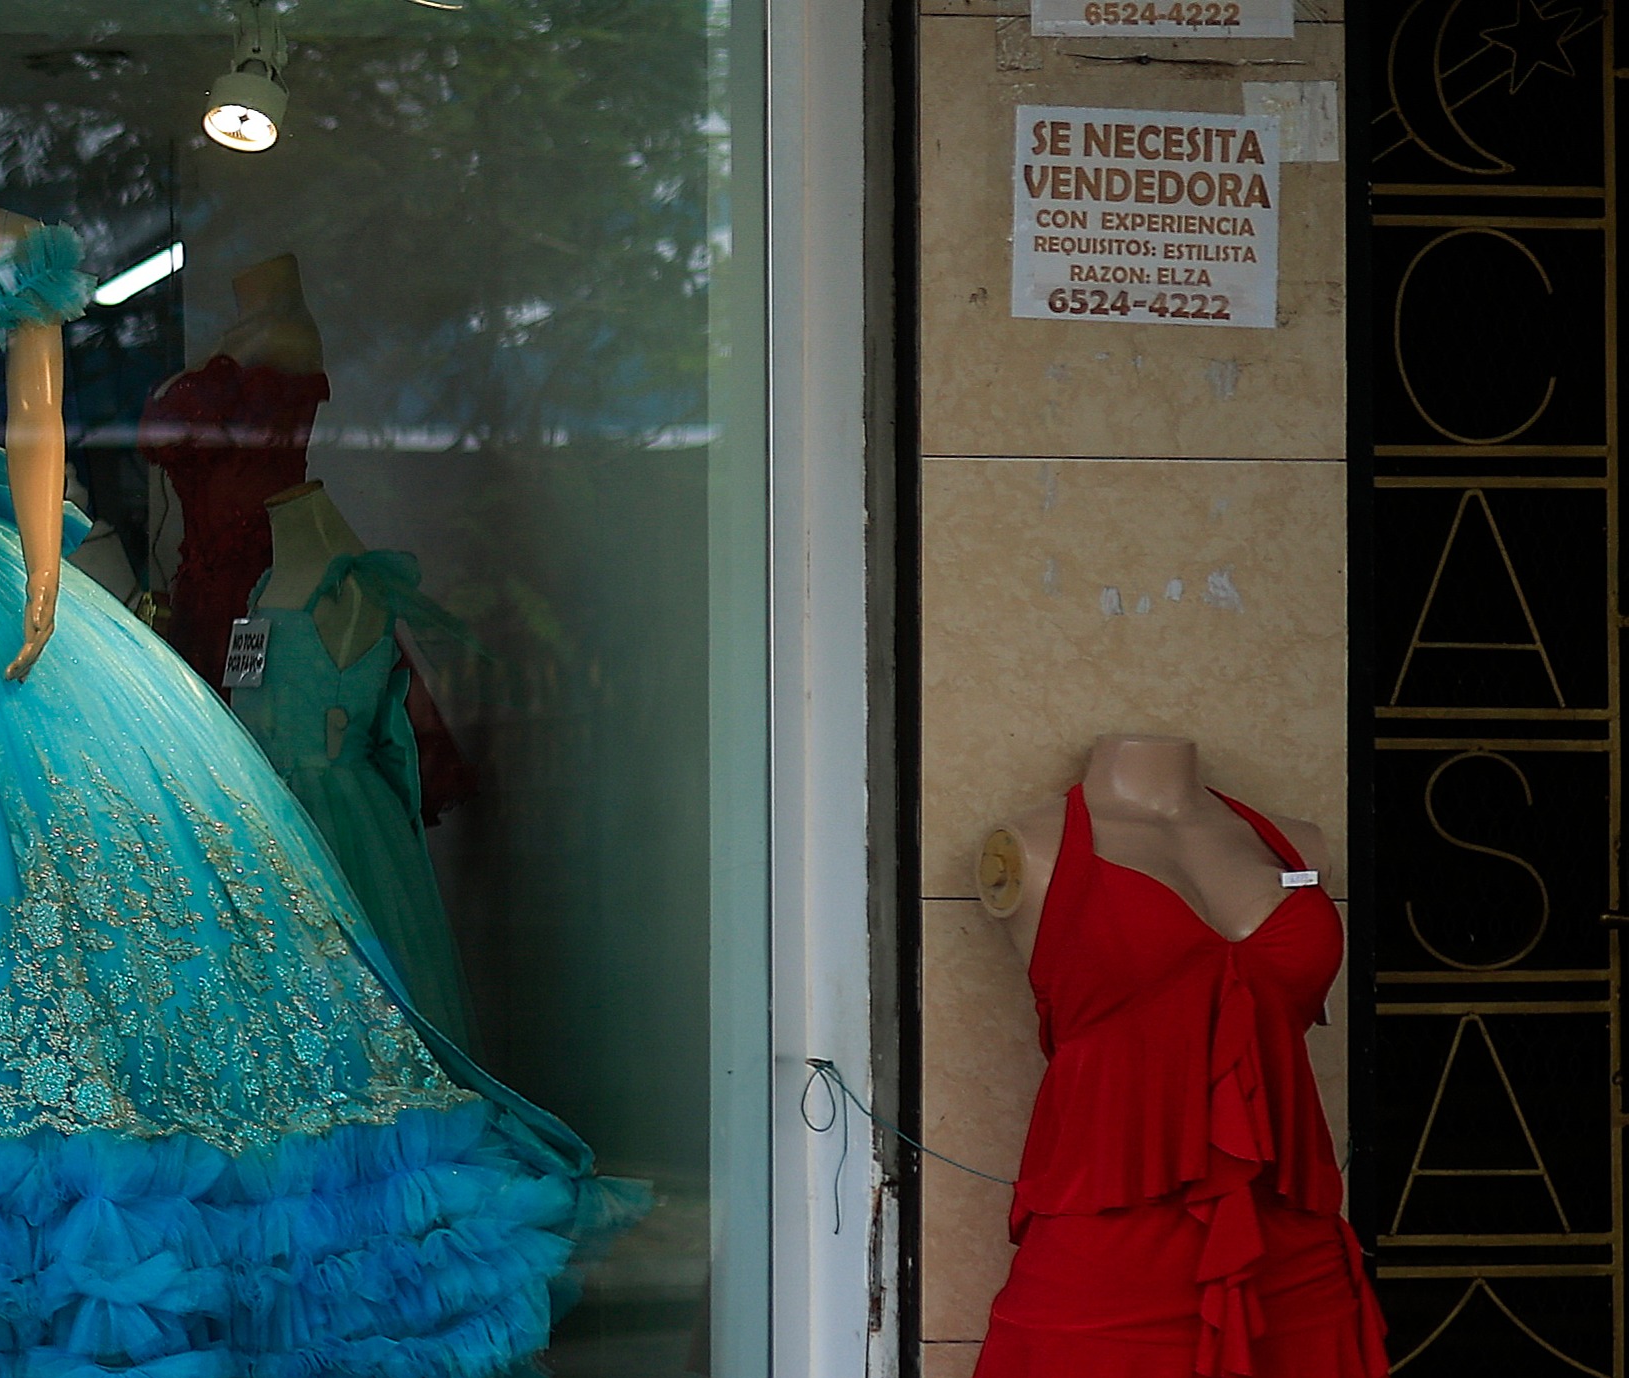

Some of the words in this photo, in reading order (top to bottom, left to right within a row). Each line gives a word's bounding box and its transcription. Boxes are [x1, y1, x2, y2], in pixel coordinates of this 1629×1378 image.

[1084, 2, 1240, 26] 6524-4222
[1032, 120, 1072, 157] SE
[1083, 121, 1265, 165] NECESITA
[1023, 164, 1272, 209] VENDEDORA
[1036, 209, 1088, 230] CON
[1101, 211, 1255, 237] EXPERIENCIA
[1034, 235, 1157, 257] REQUISITOS:
[1163, 243, 1257, 264] ESTILISTA
[1070, 264, 1151, 285] RAZON:
[1156, 266, 1212, 287] ELZA
[1048, 287, 1231, 321] 6524-4222
[1389, 225, 1571, 1236] CASA
